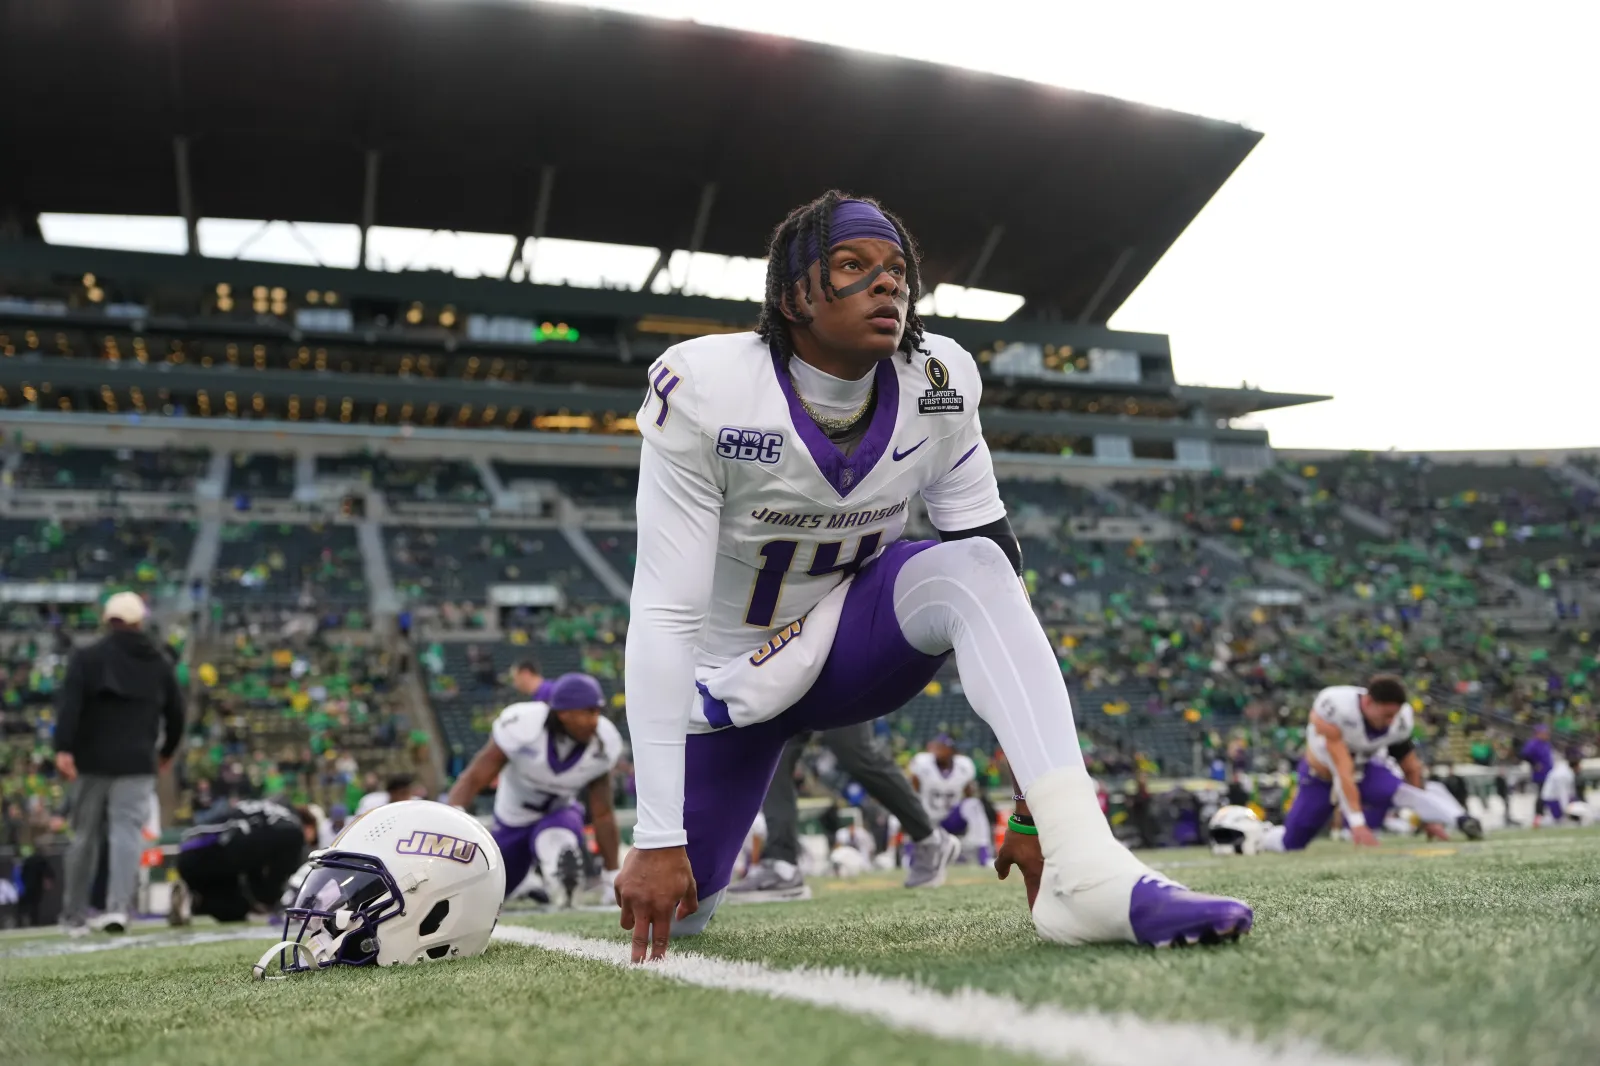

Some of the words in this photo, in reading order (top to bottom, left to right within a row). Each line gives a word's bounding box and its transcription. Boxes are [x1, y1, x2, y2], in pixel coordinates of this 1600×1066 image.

[920, 397, 941, 406] FIRST
[926, 390, 956, 398] PLAYOFF
[716, 427, 784, 464] SBC
[751, 507, 825, 529] JAMES
[825, 497, 908, 529] MADISON
[743, 529, 885, 629] 14
[749, 616, 808, 668] JM
[396, 830, 478, 864] JMU
